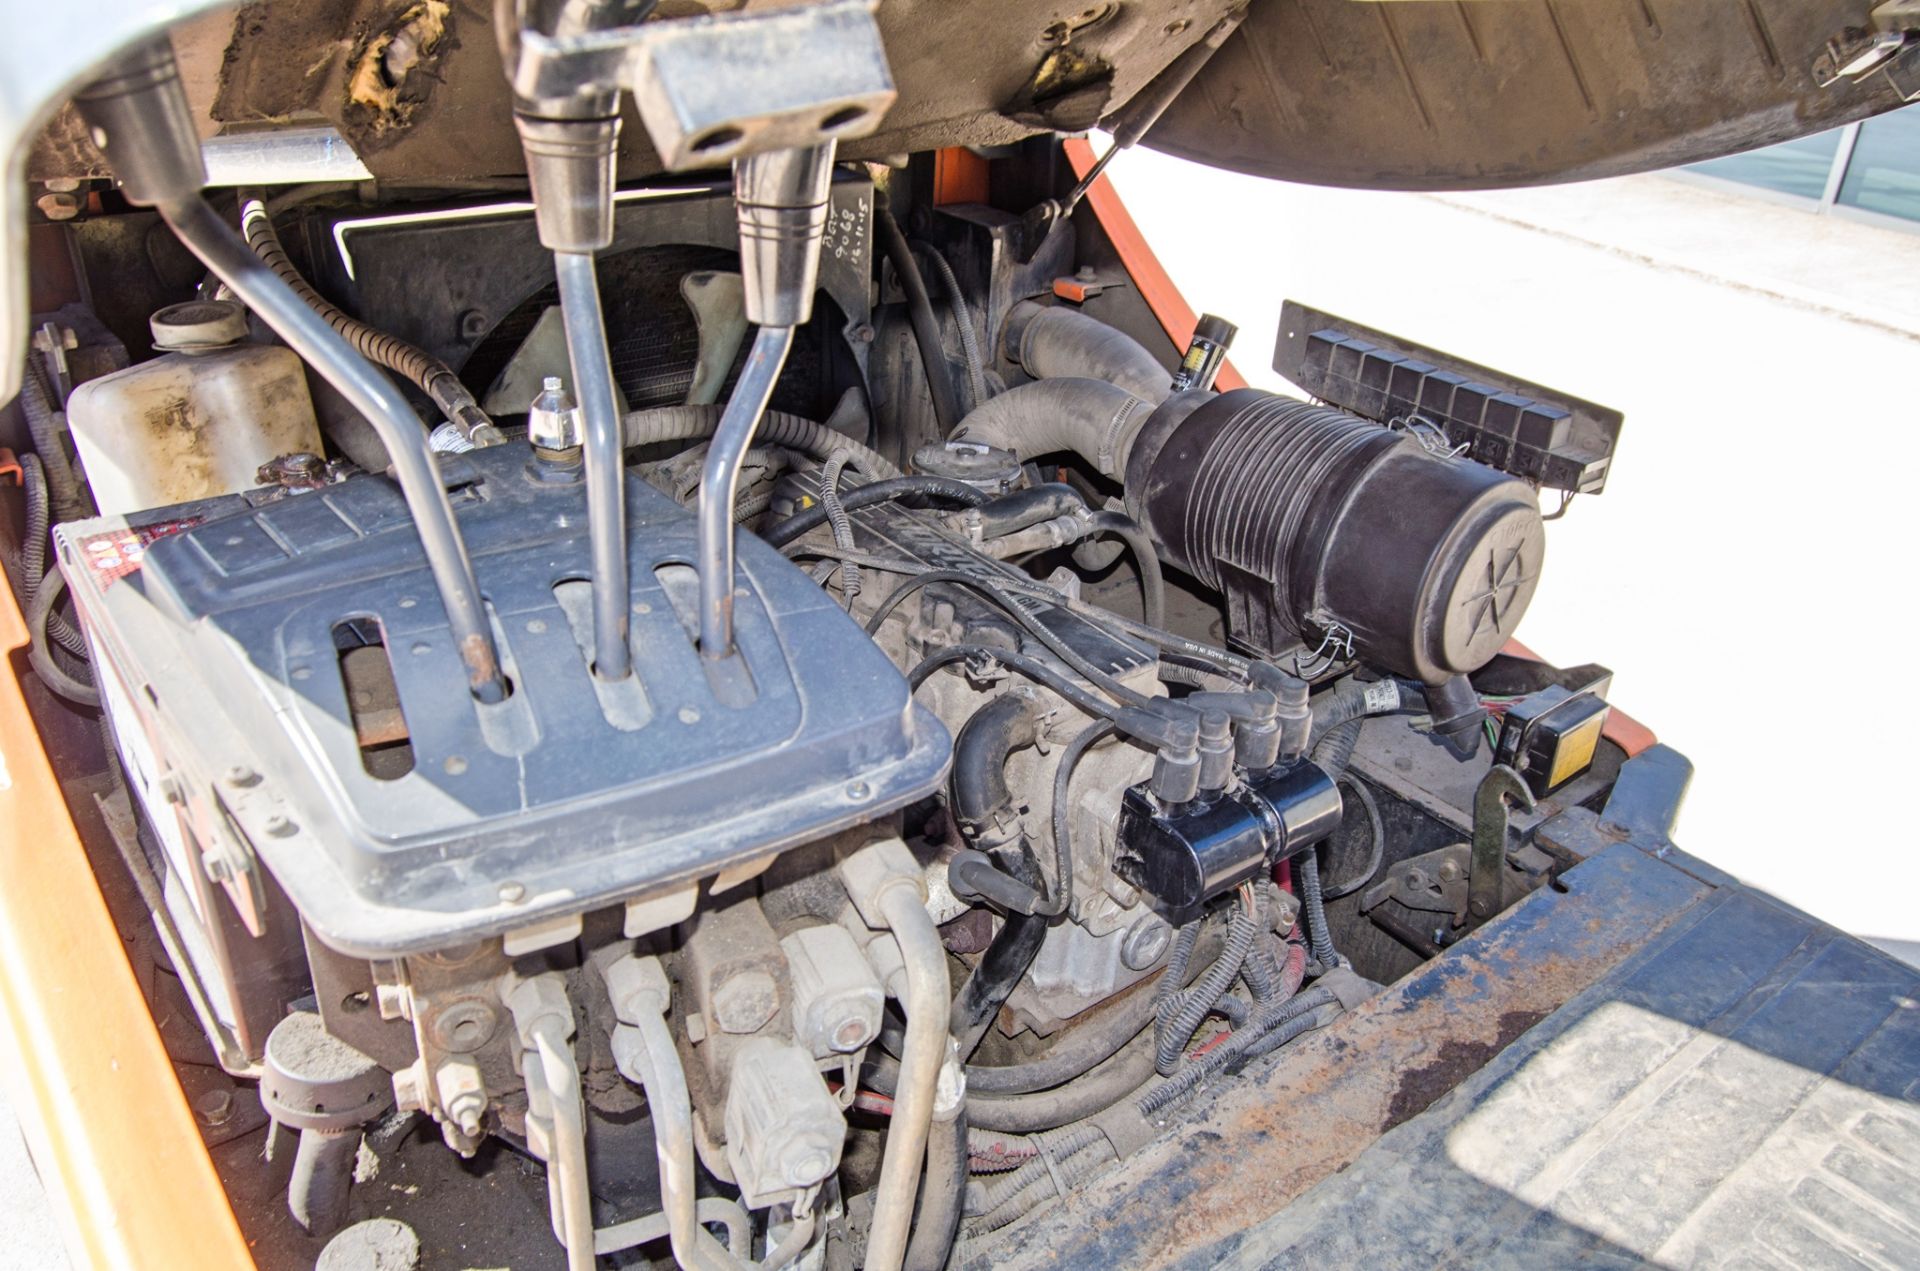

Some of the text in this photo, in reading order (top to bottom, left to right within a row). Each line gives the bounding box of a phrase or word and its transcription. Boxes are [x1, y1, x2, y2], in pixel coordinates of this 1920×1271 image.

[835, 209, 856, 259] 9068
[887, 517, 1001, 579] VORTE
[1017, 597, 1042, 610] GM
[1185, 642, 1198, 652] USA
[1207, 649, 1224, 660] MADE
